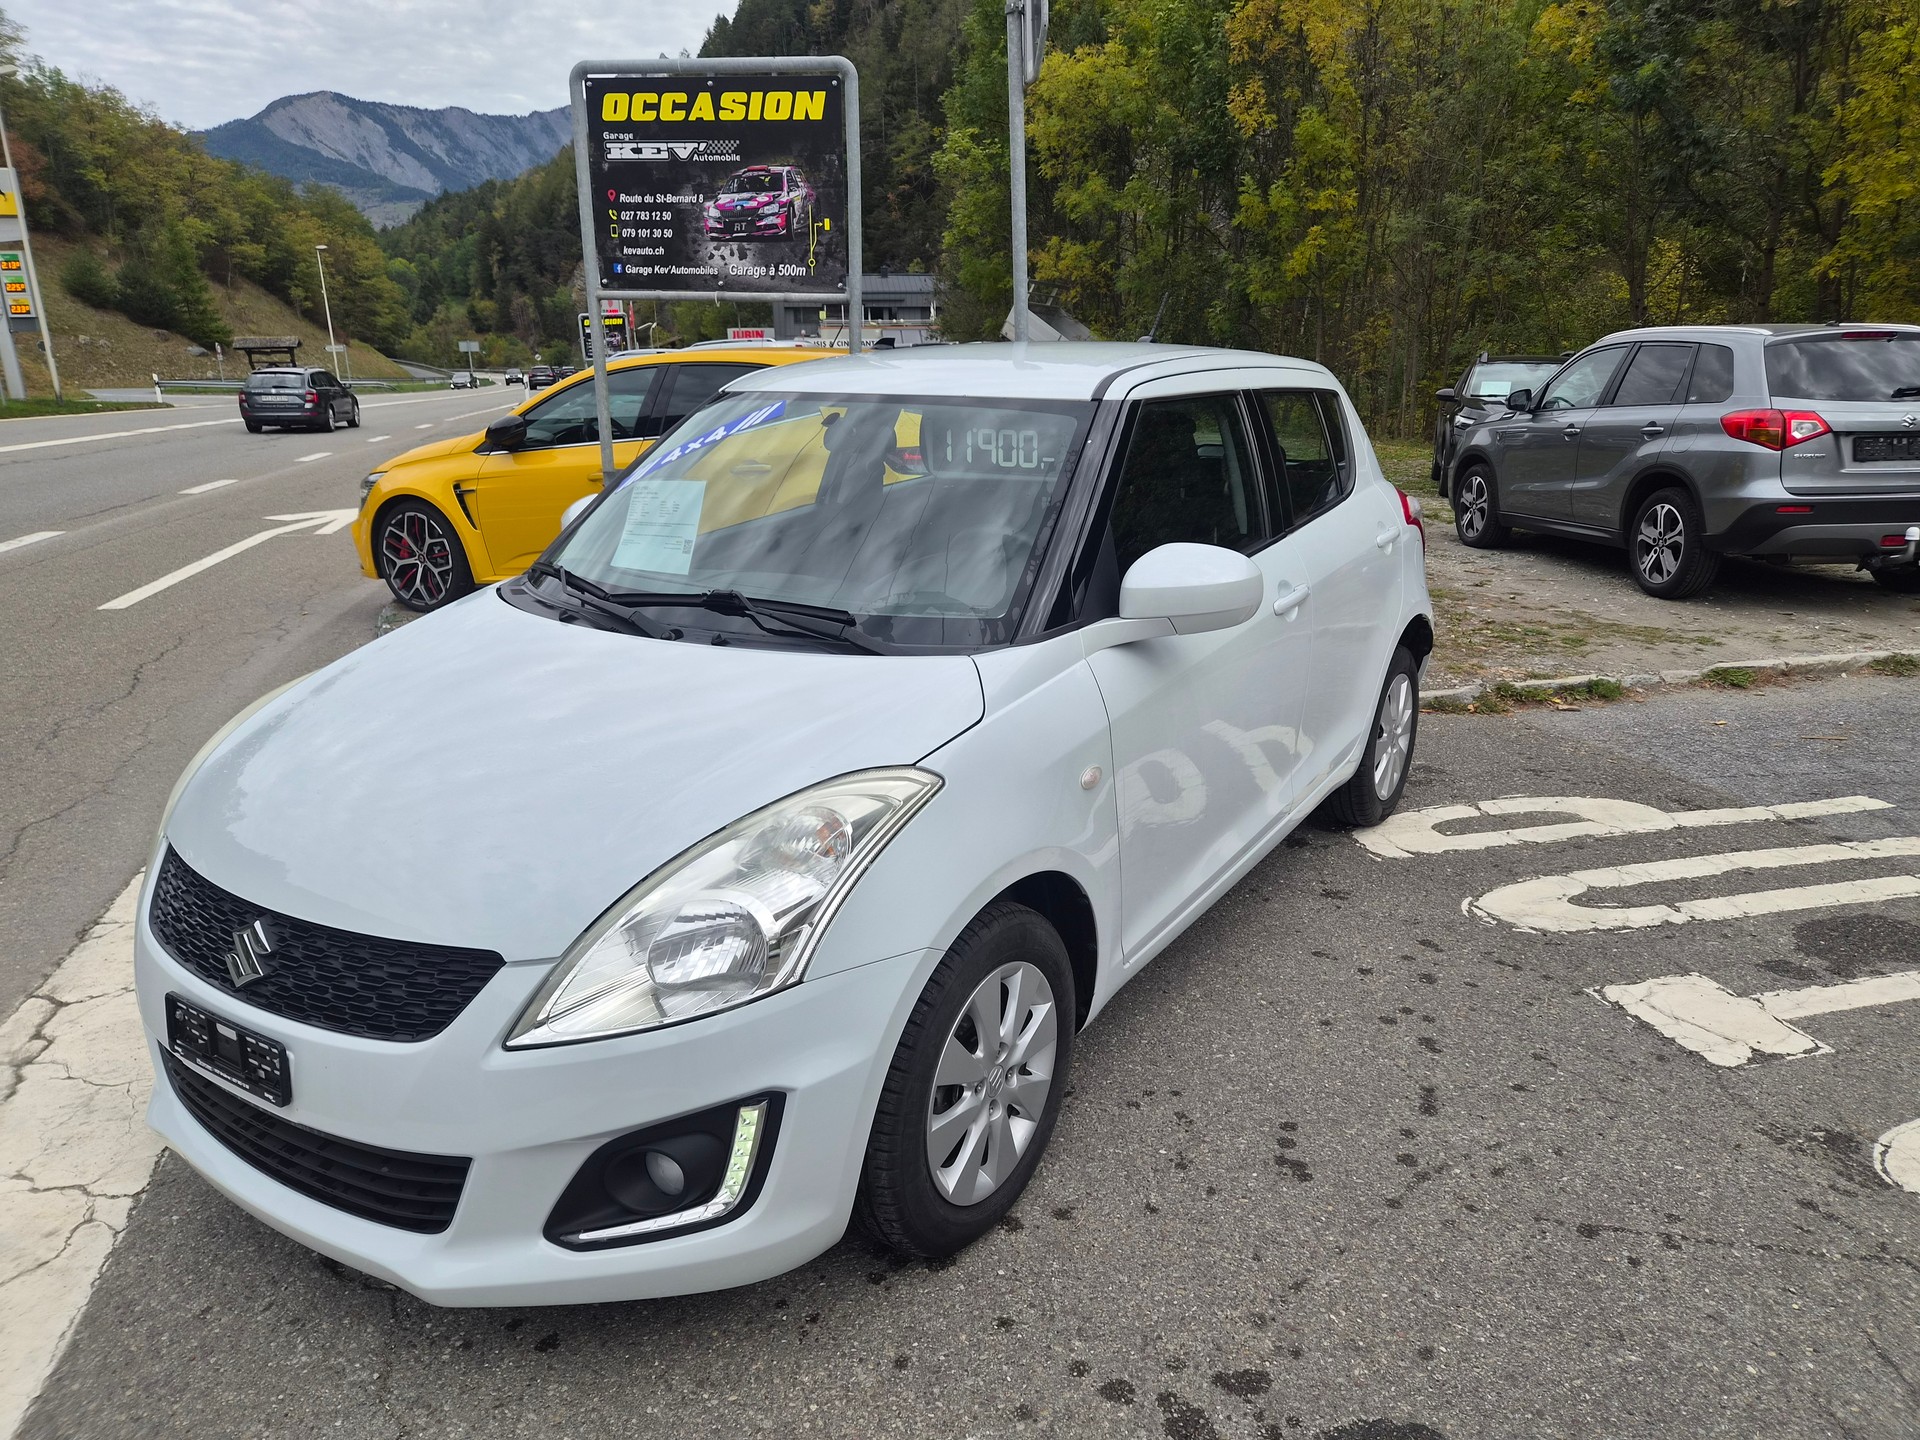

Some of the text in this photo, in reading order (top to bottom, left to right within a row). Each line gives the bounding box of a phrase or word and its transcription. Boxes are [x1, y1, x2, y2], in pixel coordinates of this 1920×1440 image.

[601, 91, 827, 122] OCCASION
[603, 131, 634, 141] Garage
[692, 153, 741, 162] Automobile
[619, 193, 704, 203] Route du St-Bernard 8
[620, 211, 672, 221] 027 783 12 50
[621, 228, 673, 238] 079 101 30 50
[623, 245, 665, 256] kevauto.ch
[625, 264, 719, 276] Garage Kev'Automobiles
[729, 263, 807, 279] Garage à 500m
[583, 317, 623, 327] OSION
[661, 426, 727, 465] 4x4
